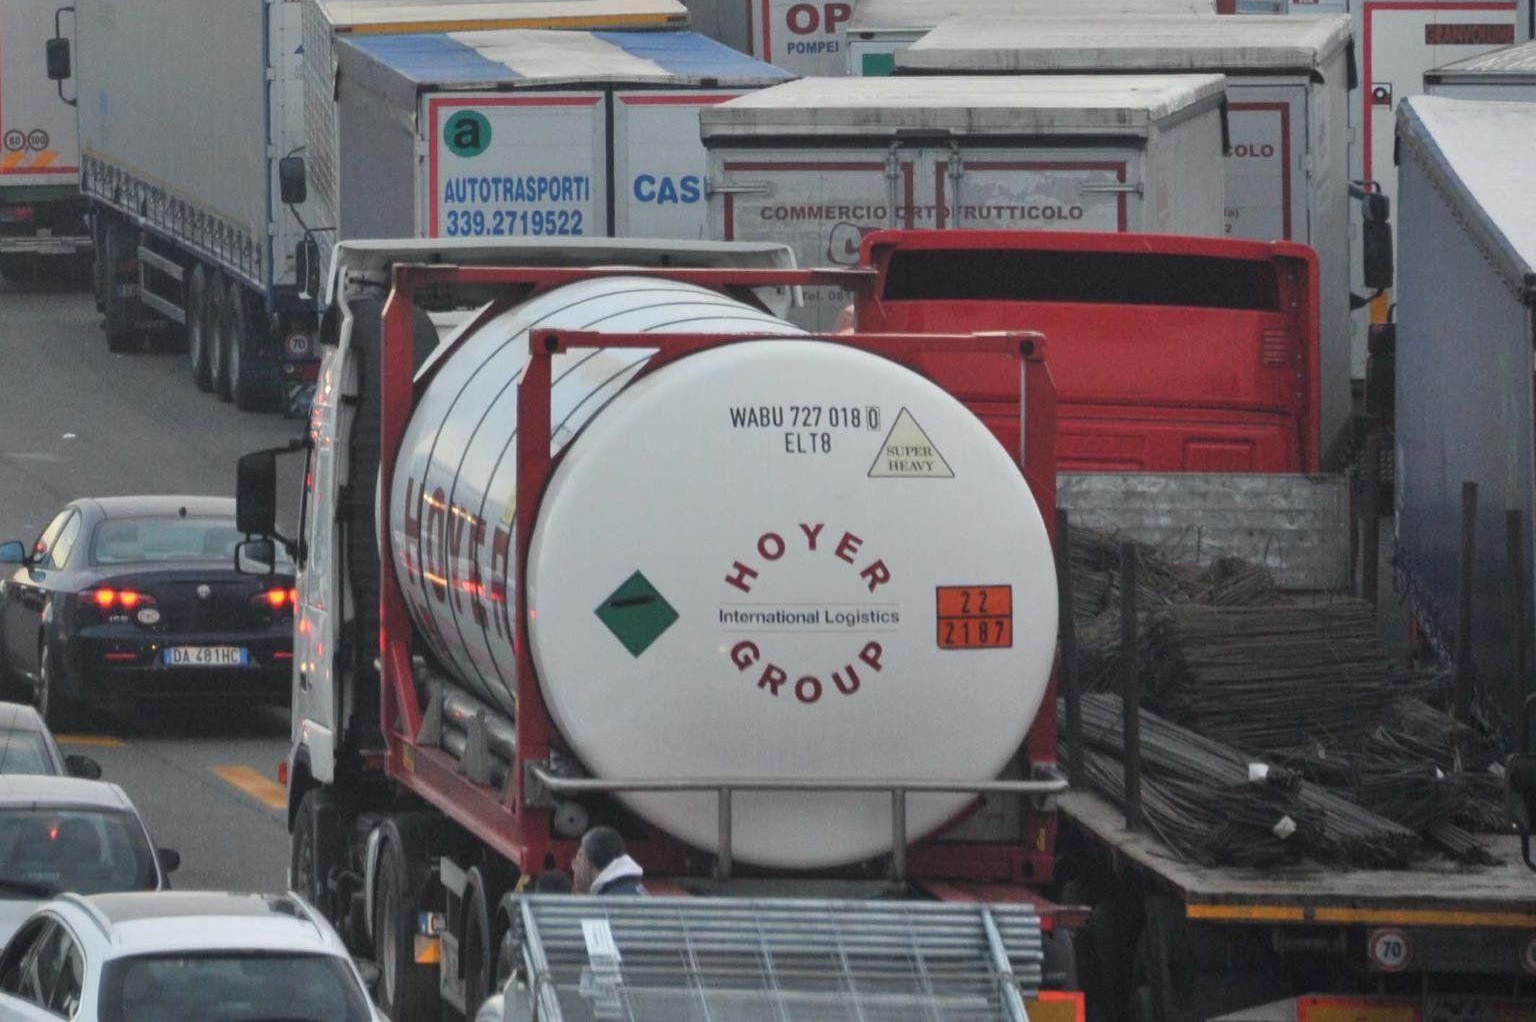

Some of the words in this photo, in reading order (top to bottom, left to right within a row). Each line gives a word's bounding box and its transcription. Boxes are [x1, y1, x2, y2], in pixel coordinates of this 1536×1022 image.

[785, 3, 852, 35] OP
[787, 41, 840, 55] POMPEI
[444, 176, 590, 203] AUTOTRASPORTI
[446, 210, 584, 236] 339.2719522
[760, 206, 888, 221] COMMERCIO
[292, 339, 305, 350] 70
[730, 407, 784, 428] WABU
[790, 407, 822, 427] 727
[829, 408, 861, 428] 018
[785, 432, 832, 453] ELT8
[886, 445, 934, 457] SUPER
[888, 460, 934, 472] HEAVY
[724, 523, 892, 594] HOYER
[719, 609, 821, 625] International
[825, 609, 900, 627] Logistics
[944, 621, 1004, 645] 2187
[729, 640, 886, 704] GROUP
[1383, 941, 1402, 956] 70
